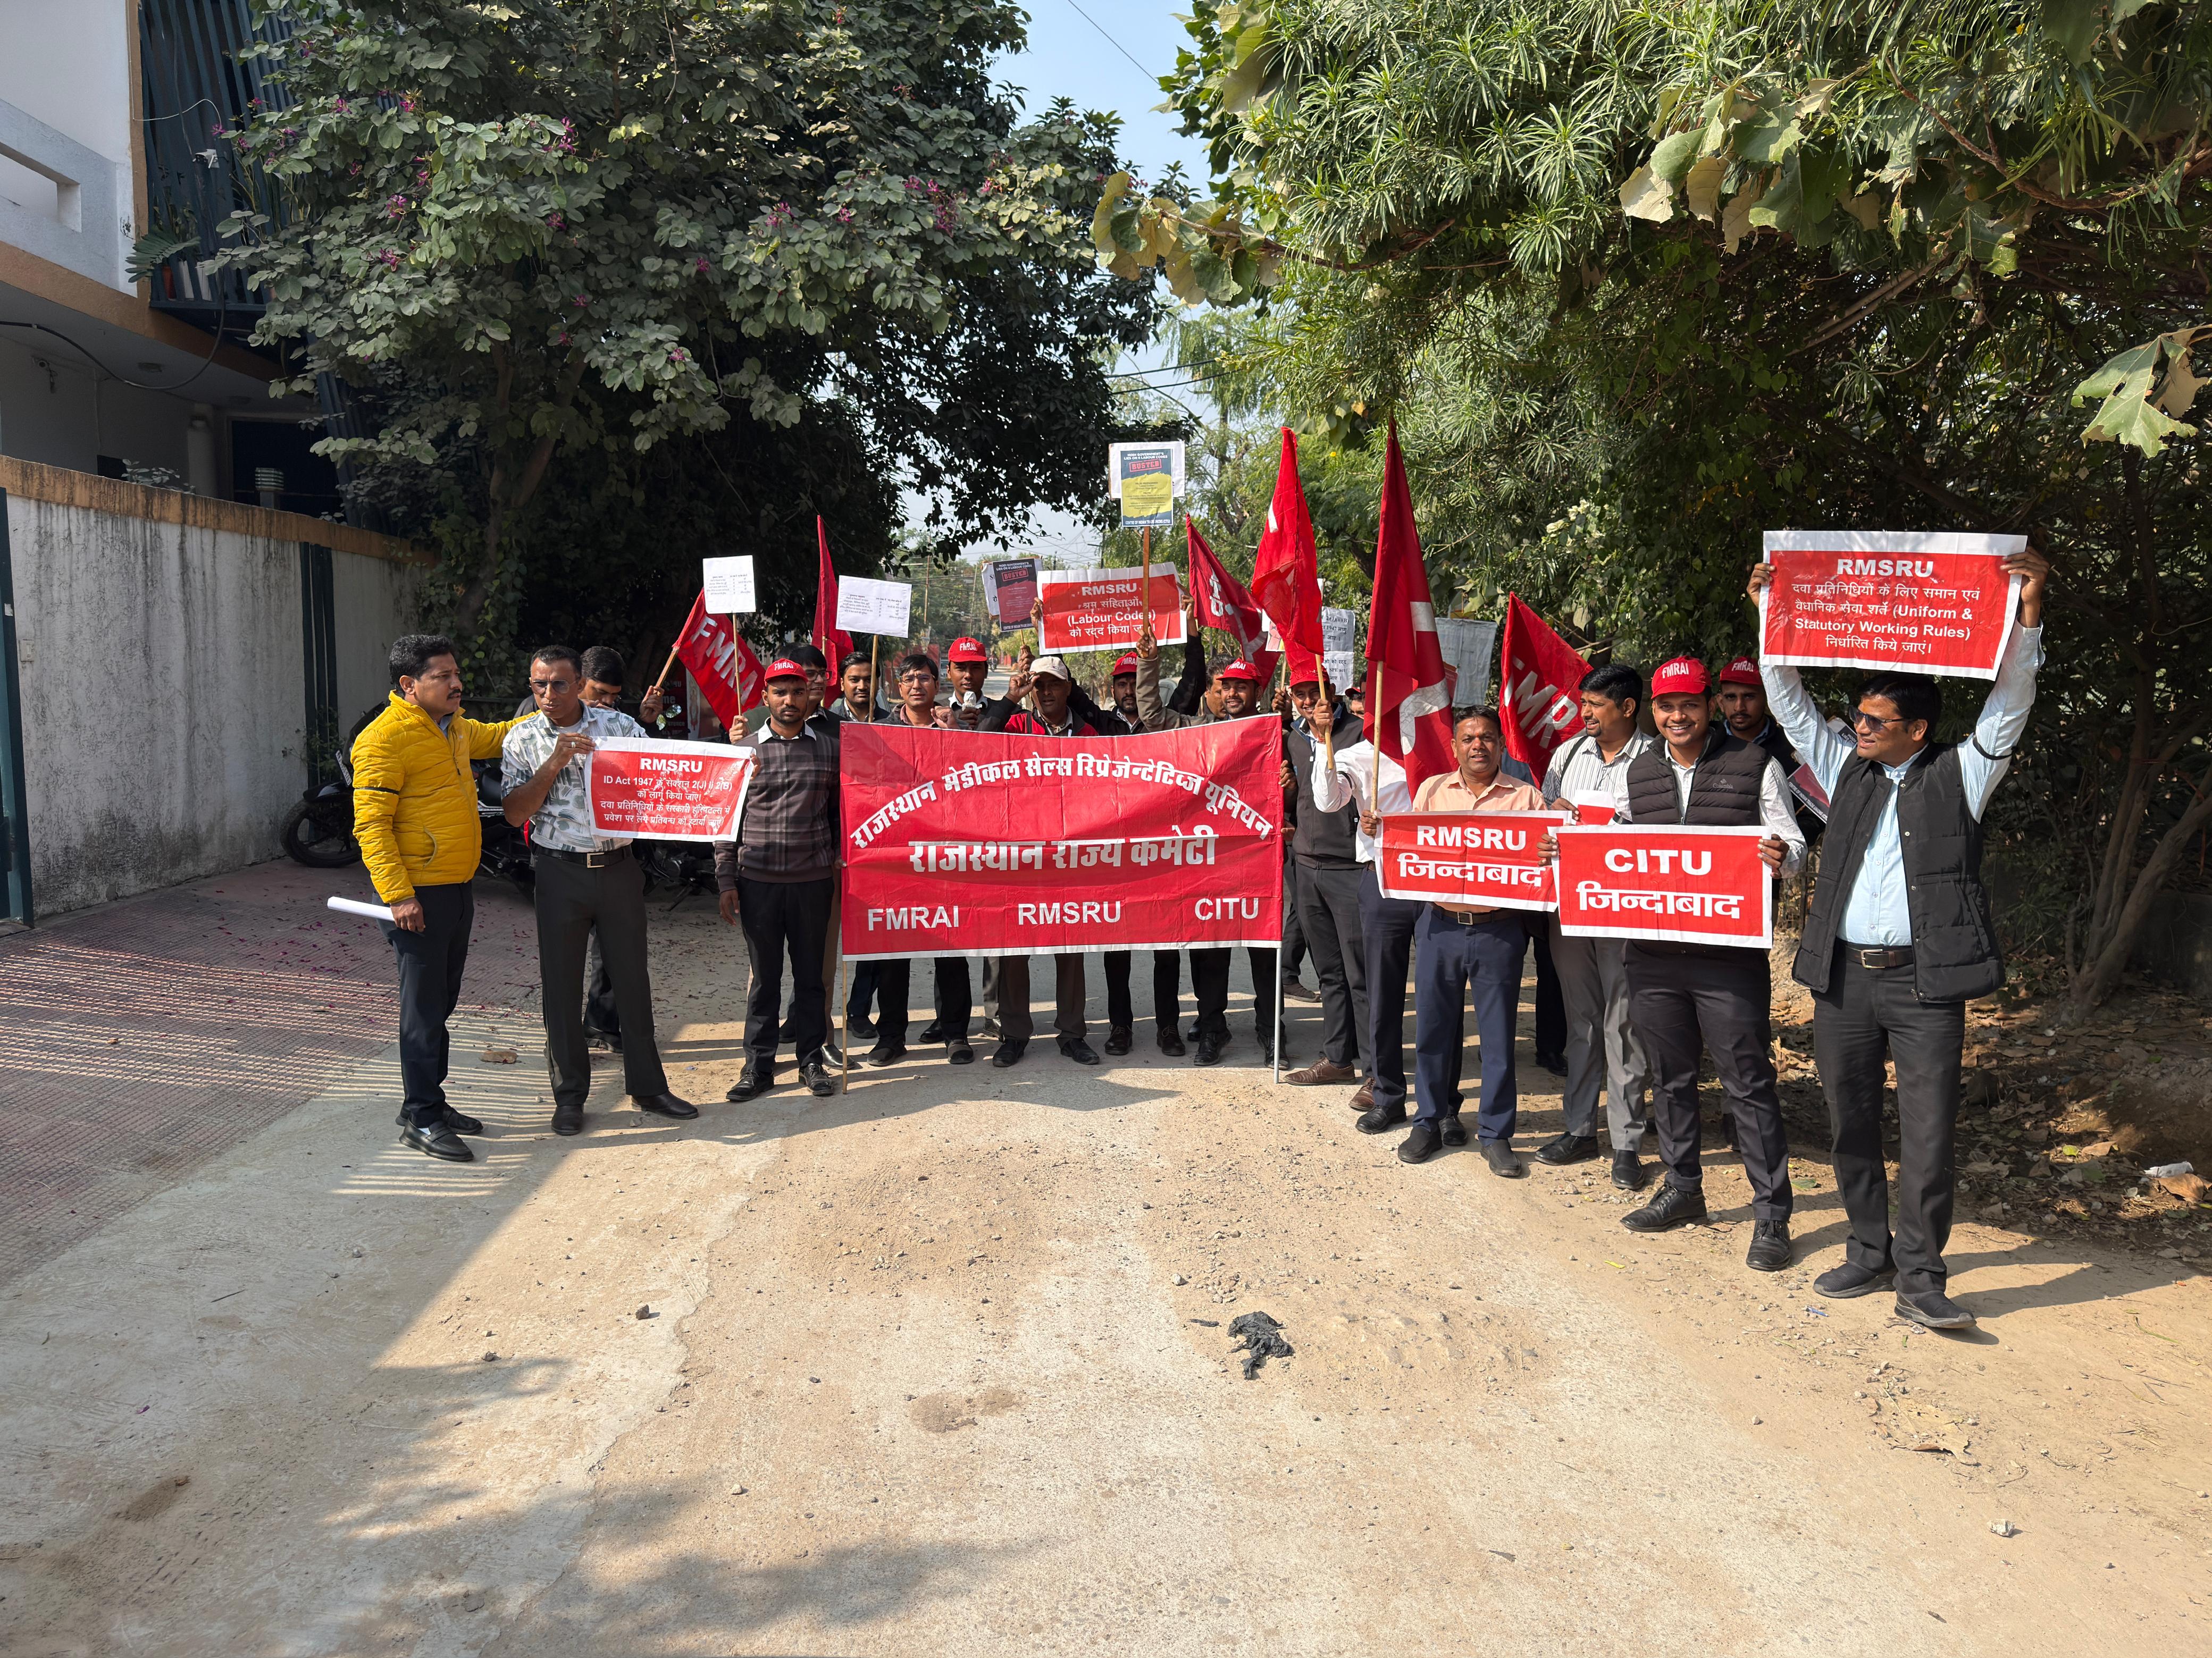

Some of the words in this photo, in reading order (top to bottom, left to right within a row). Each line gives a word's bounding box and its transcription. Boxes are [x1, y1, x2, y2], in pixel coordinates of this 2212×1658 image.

[1132, 461, 1160, 470] BUSTED
[1004, 569, 1027, 579] BUSTED
[1837, 559, 1933, 578] RMSRU
[1082, 583, 1137, 596] RMSRU
[1791, 584, 1812, 594] दवा
[1815, 581, 1874, 596] प्रतिनिधियों
[1878, 583, 1890, 596] के
[1895, 583, 1918, 599] लिए
[1922, 588, 1957, 600] समान
[1961, 587, 1980, 602] एवं
[1100, 596, 1139, 609] संहिताओं
[1795, 598, 1836, 612] वैधानिक
[1840, 600, 1863, 613] सेवा
[1893, 604, 1957, 619] (Uniform
[1962, 608, 1973, 620] &
[1068, 614, 1112, 627] (Labour
[1069, 626, 1082, 637] को
[1107, 624, 1129, 635] किया
[1795, 618, 1855, 634] Statutory
[1859, 621, 1918, 637] Working
[1923, 625, 1971, 641] Rules)
[959, 642, 977, 651] FMRAI
[1825, 634, 1869, 649] निर्धारित
[1873, 636, 1897, 652] किये
[774, 662, 793, 671] FMRAI
[1662, 662, 1689, 679] FMRAI
[1731, 660, 1754, 672] FMRAI
[640, 758, 703, 773] RMSRU
[615, 776, 631, 785] Act
[666, 778, 690, 789] सेक्शन
[692, 780, 707, 790] 2(J)
[637, 789, 647, 798] को
[649, 788, 665, 802] लागू
[666, 790, 683, 799] किया
[850, 780, 937, 849] राजस्थान
[941, 760, 1021, 792] मेडीकल
[1024, 752, 1074, 777] सेल्स
[1076, 753, 1204, 795] रिप्रेजेन्टेटिव्ज
[1204, 780, 1273, 840] यूनियन
[600, 801, 614, 809] दवा
[617, 800, 653, 811] प्रतिनिधियों
[656, 802, 664, 812] के
[666, 803, 691, 813] सरकारी
[604, 812, 622, 822] प्रवेश
[650, 814, 676, 824] प्रतिबन्ध
[678, 815, 687, 824] को
[1417, 825, 1526, 851] RMSRU
[908, 840, 1046, 872] राजस्थान
[1051, 838, 1126, 869] राज्य
[1129, 824, 1219, 866] कमेटी
[1397, 852, 1546, 887] जिन्दाबाद
[1604, 848, 1712, 876] CITU
[1576, 880, 1745, 919] जिन्दाबाद
[867, 905, 959, 931] FMRAI
[1018, 900, 1121, 926] RMSRU
[1194, 896, 1259, 921] CITU
